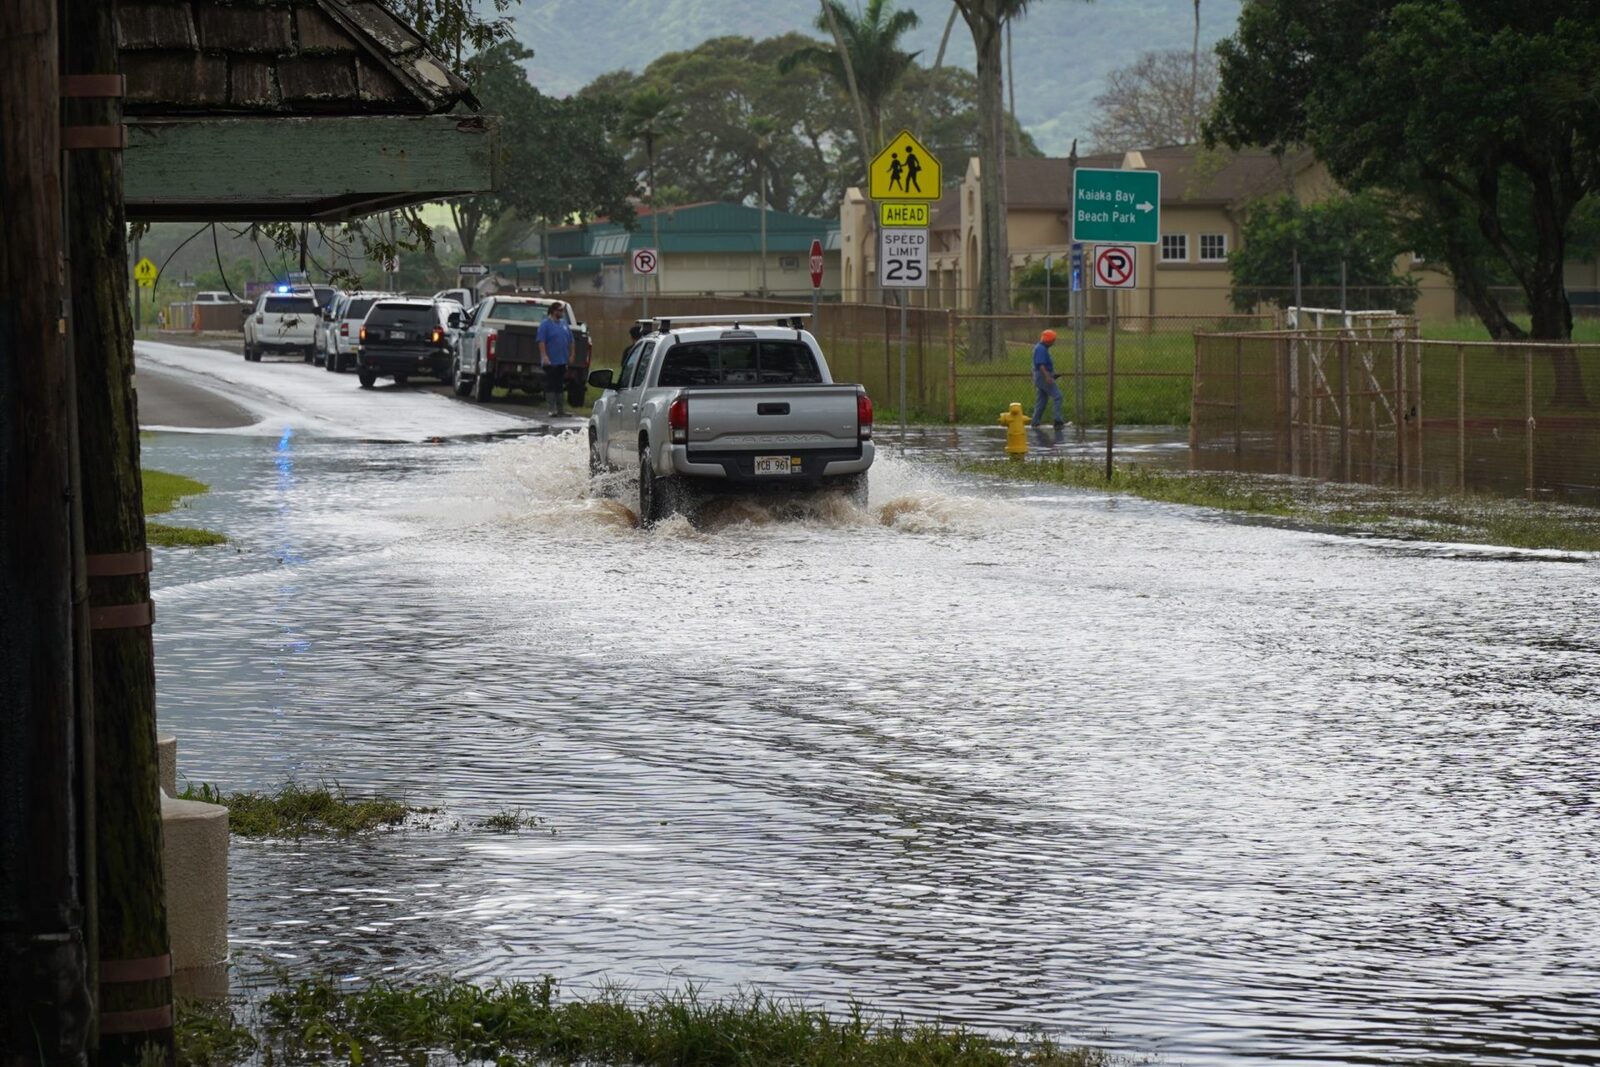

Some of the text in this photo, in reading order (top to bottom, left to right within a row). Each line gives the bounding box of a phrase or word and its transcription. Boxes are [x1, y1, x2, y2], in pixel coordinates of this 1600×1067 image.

[1078, 189, 1135, 204] Kaiaka Bay
[886, 207, 925, 221] AHEAD
[1078, 210, 1136, 223] Beach Park
[885, 234, 925, 245] SPEED
[889, 247, 920, 257] LIMIT
[886, 259, 923, 281] 25
[725, 434, 825, 444] TACOMA
[756, 460, 771, 471] YCB
